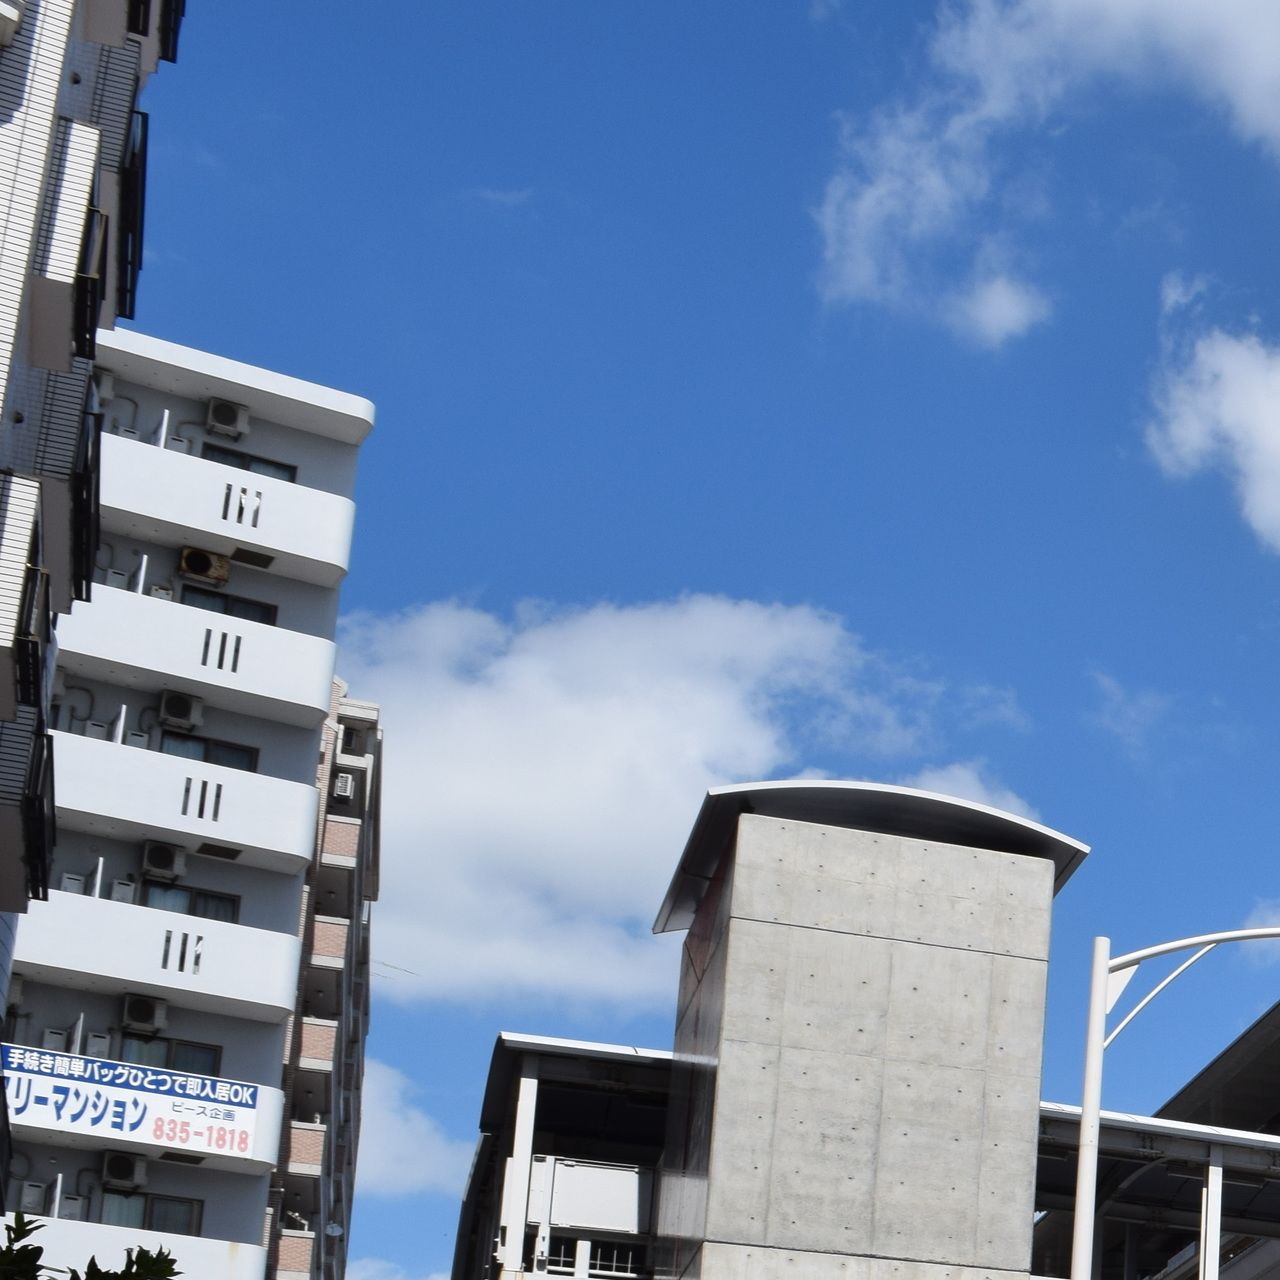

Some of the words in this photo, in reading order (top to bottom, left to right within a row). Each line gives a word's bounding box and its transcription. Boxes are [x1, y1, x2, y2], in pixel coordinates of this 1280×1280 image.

[8, 1049, 254, 1105] 手続き簡単バッグひとつで即入居OK
[152, 1117, 249, 1152] 835-1818
